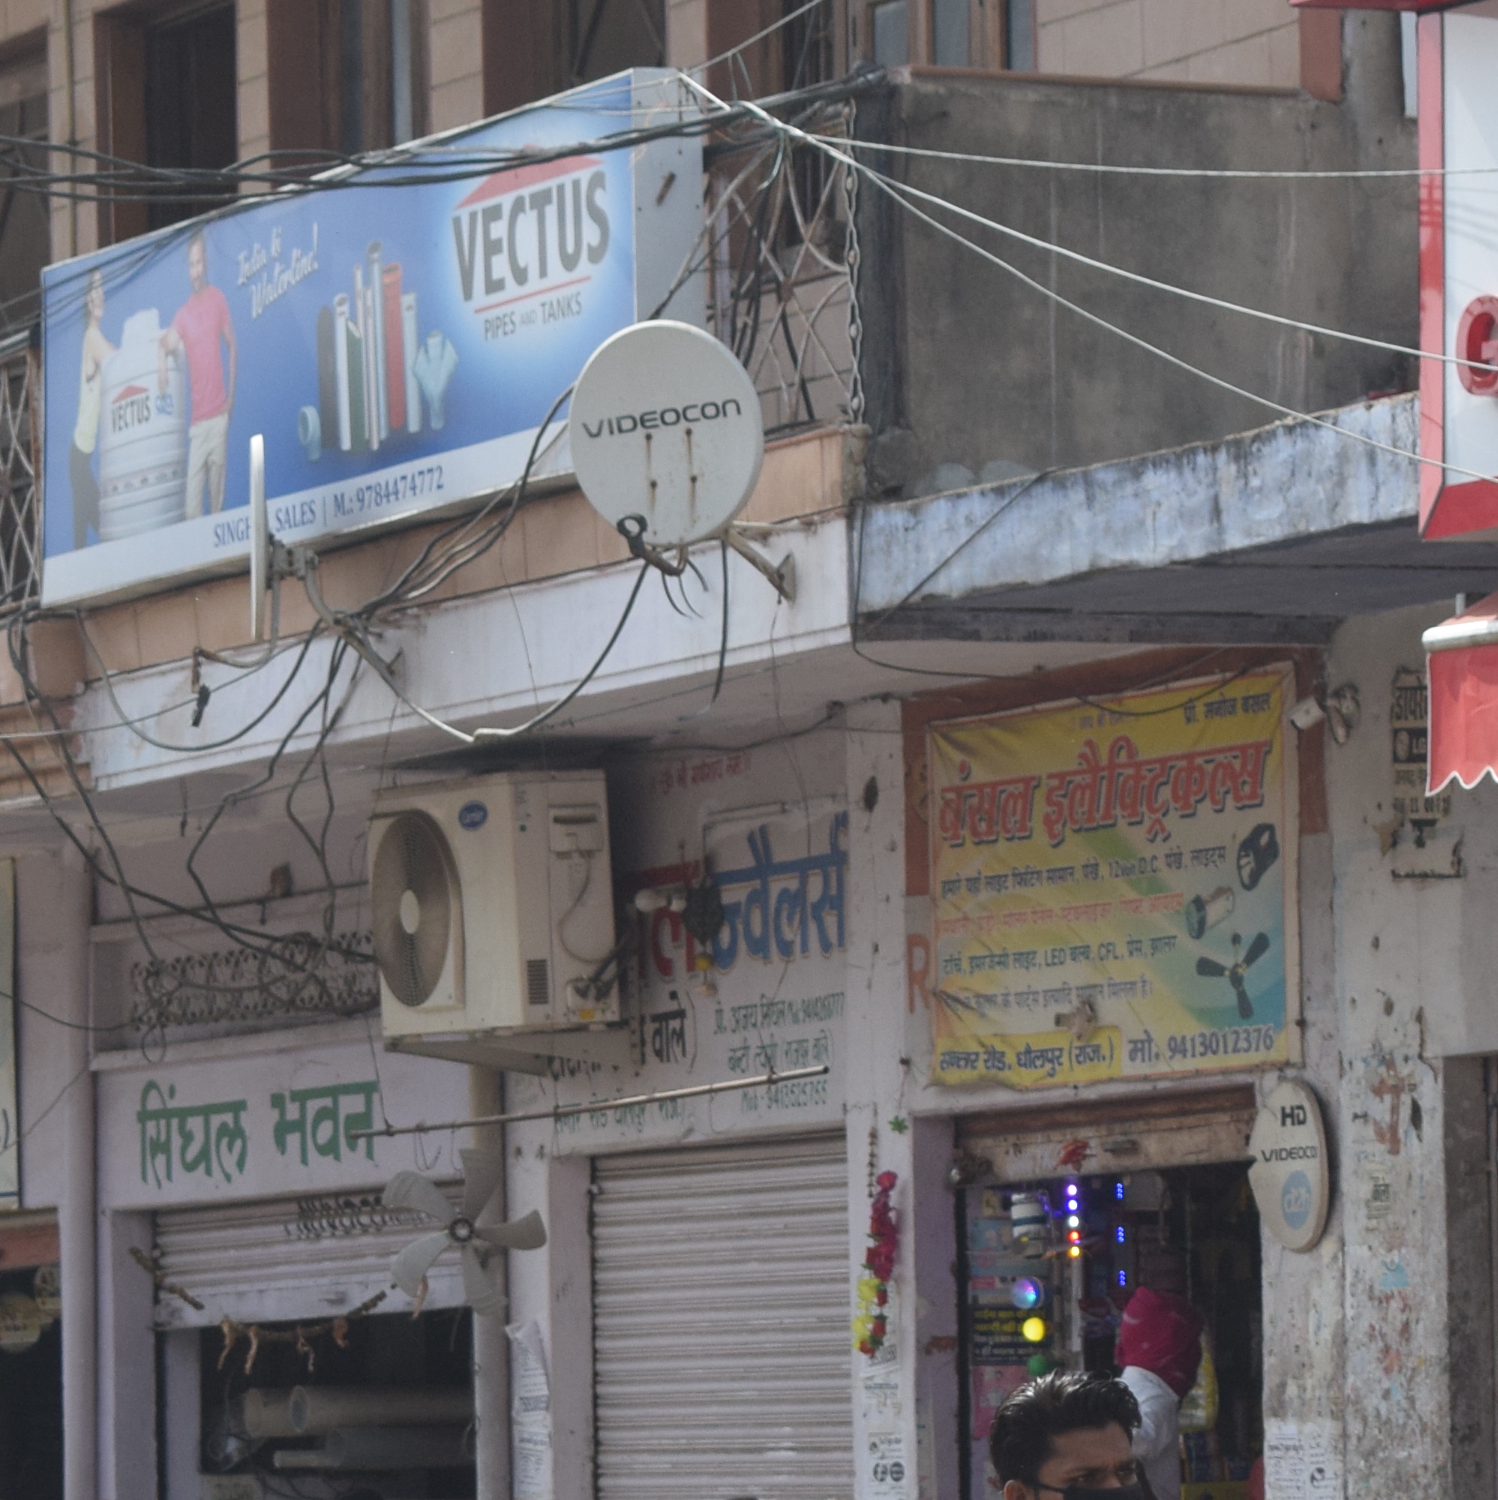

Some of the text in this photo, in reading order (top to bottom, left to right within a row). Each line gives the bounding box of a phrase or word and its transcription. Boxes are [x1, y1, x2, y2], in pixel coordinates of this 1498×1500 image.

[452, 170, 611, 303] VECTUS
[484, 310, 517, 342] PIPES
[540, 292, 583, 325] TANKS
[111, 394, 152, 433] VECTUS
[582, 398, 742, 439] VIDEOCON
[274, 498, 317, 533] SALES
[357, 465, 445, 512] 9784474772
[938, 756, 1041, 850] बंसल
[1044, 946, 1067, 968] LED
[1166, 1023, 1275, 1061] 9413012376
[136, 1080, 381, 1190] सिंघल भवन
[1280, 1104, 1308, 1127] HD
